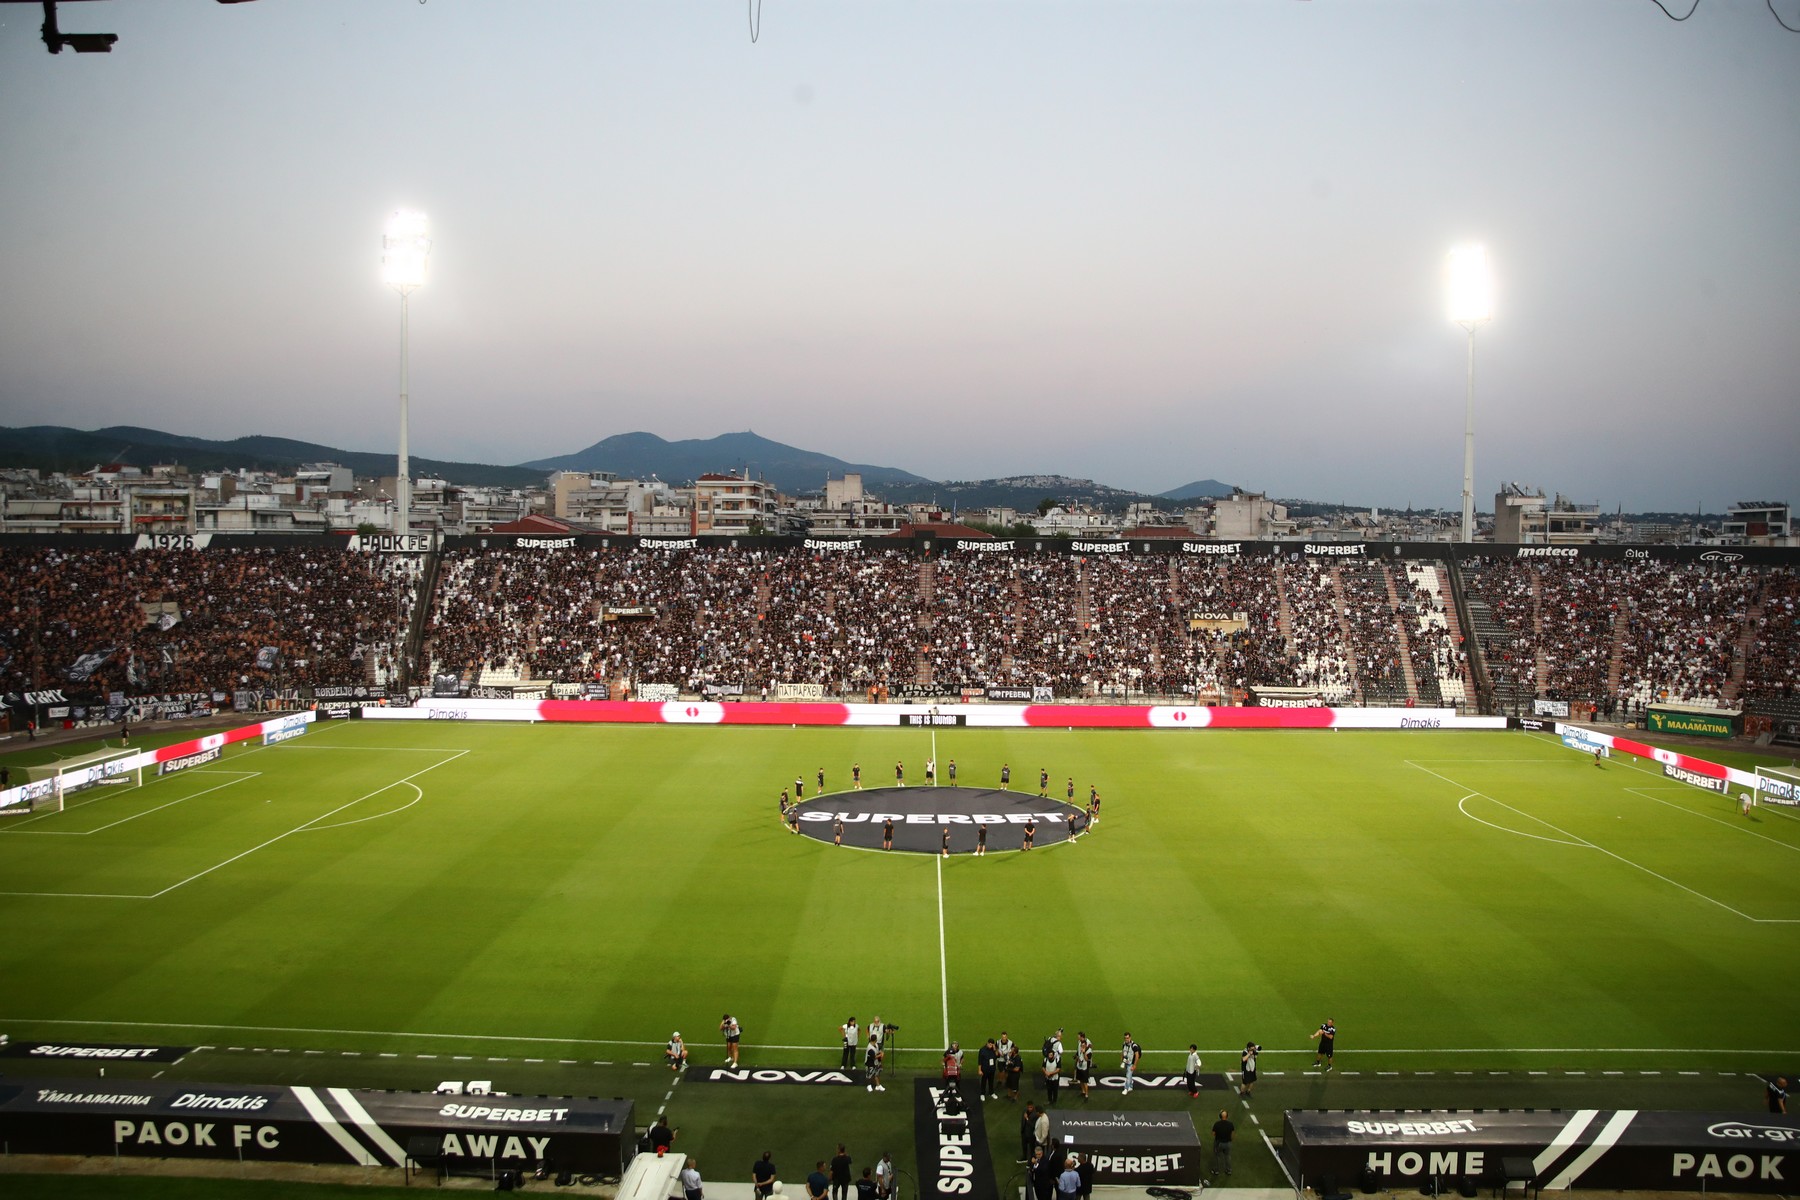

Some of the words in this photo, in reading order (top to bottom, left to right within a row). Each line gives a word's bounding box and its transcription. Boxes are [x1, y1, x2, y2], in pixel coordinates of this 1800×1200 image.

[149, 535, 194, 549] 1926
[359, 535, 403, 550] PAOK
[408, 535, 428, 550] FC
[516, 537, 576, 549] SUPERBET
[640, 538, 698, 550] SUPERBET
[804, 538, 862, 551] SUPERBET
[957, 540, 1015, 552] SUPERBET
[1071, 541, 1130, 553] SUPERBET
[1182, 542, 1241, 554] SUPERBET
[1304, 543, 1365, 556] SUPERBET
[1518, 547, 1578, 557] mateco
[1194, 612, 1229, 620] NOVA
[513, 690, 547, 700] ERBET
[903, 684, 944, 692] ΠΑΟΚ
[24, 689, 69, 705] ARMY
[428, 708, 468, 720] Dimakis
[909, 715, 923, 725] THIS
[924, 715, 931, 725] IS
[932, 715, 957, 725] TOUMBA
[283, 715, 307, 729] Dimakis
[1401, 717, 1441, 729] Dimakis
[1667, 720, 1728, 734] ΜΑΛΑΜΑΤΙΝΑ
[1563, 725, 1589, 740] Dimakis
[165, 747, 220, 772] SUPERBET
[1665, 764, 1722, 790] SUPERBET
[1760, 777, 1800, 801] Dimaks
[798, 811, 1066, 825] SUPERBET
[30, 1045, 159, 1058] SUPERBET
[709, 1069, 853, 1083] NOVA
[48, 1091, 152, 1106] ΜΑΛΑΜΑΤΙΝΑ
[170, 1093, 269, 1111] Dimakis
[439, 1103, 569, 1122] SUPERBET
[114, 1120, 217, 1147] PAOK
[234, 1125, 281, 1149] FC
[1348, 1119, 1476, 1136] SUPERBET
[442, 1133, 551, 1160] AWAY
[1368, 1151, 1485, 1176] HOME
[1672, 1153, 1785, 1180] PAOK
